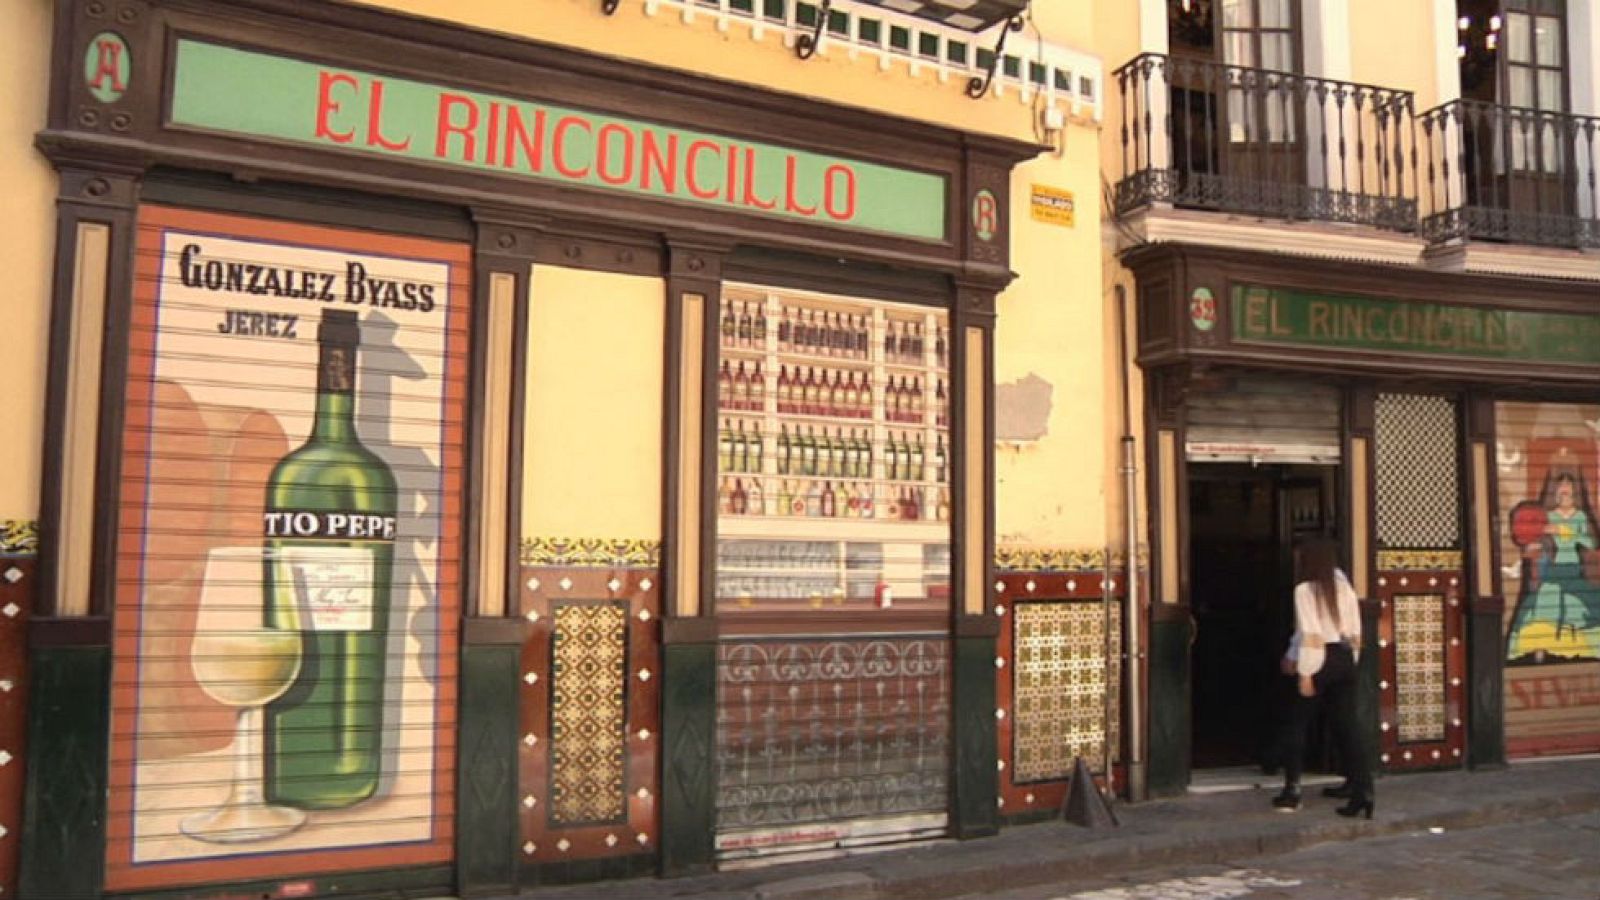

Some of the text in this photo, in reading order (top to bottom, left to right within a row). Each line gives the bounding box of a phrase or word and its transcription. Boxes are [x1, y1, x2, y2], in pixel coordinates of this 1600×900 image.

[90, 40, 126, 91] A
[314, 71, 857, 222] EL RINCONCILLO
[217, 309, 299, 339] JEREZ
[1245, 293, 1293, 335] EL
[264, 512, 395, 539] TIO PEPE
